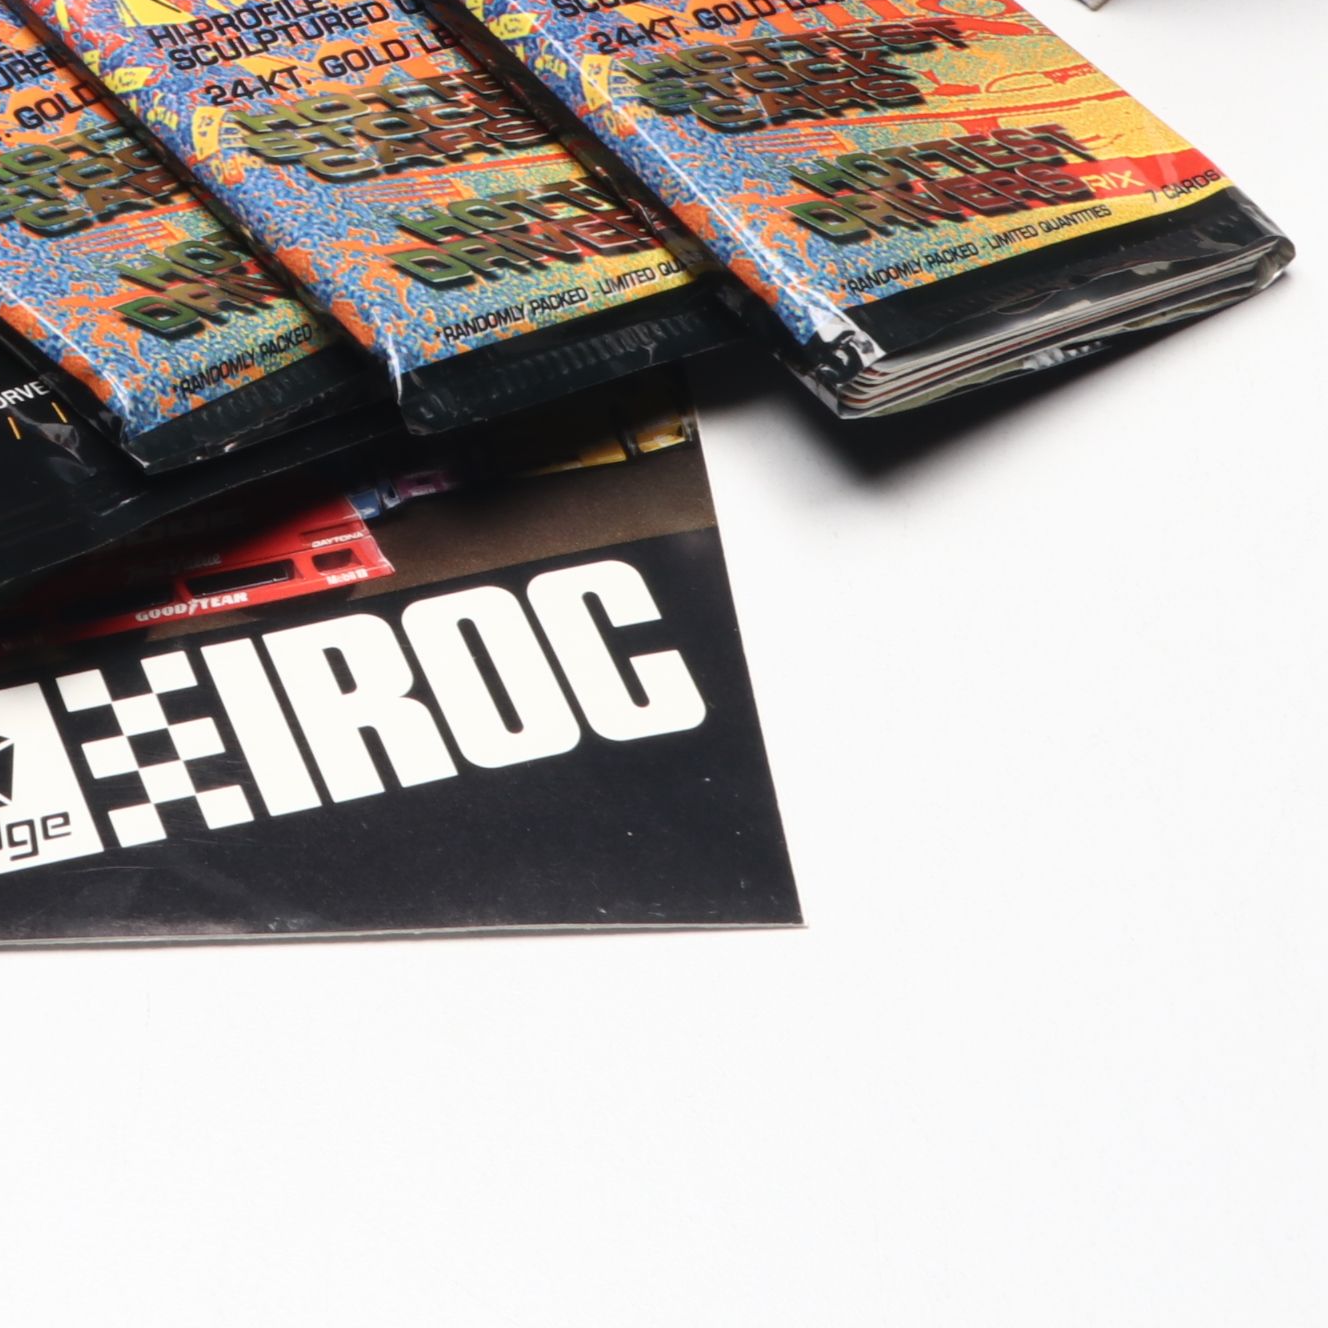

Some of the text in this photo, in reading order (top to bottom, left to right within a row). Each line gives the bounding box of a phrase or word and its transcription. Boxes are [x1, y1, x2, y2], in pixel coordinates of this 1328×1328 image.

[170, 1, 391, 71] SCULPTURED
[318, 40, 411, 79] GOLD
[617, 18, 968, 84] HOTTEST
[15, 82, 105, 128] GOLD
[637, 49, 908, 115] STOCK
[689, 73, 922, 133] CARS
[302, 116, 554, 182] CARS
[788, 123, 1096, 198] HOTTEST
[784, 162, 1096, 245] DRIVERS
[1144, 169, 1223, 205] 7 CARDS
[923, 241, 979, 272] PACKED
[985, 223, 1039, 251] LIMITED
[1039, 203, 1113, 236] QUANTITIES
[530, 287, 590, 324] PACKED
[600, 264, 658, 296] LIMITED
[257, 322, 315, 362] PACKED
[310, 531, 366, 548] DAYTONA
[134, 592, 250, 625] GOODYEAR
[200, 558, 708, 819] IROC
